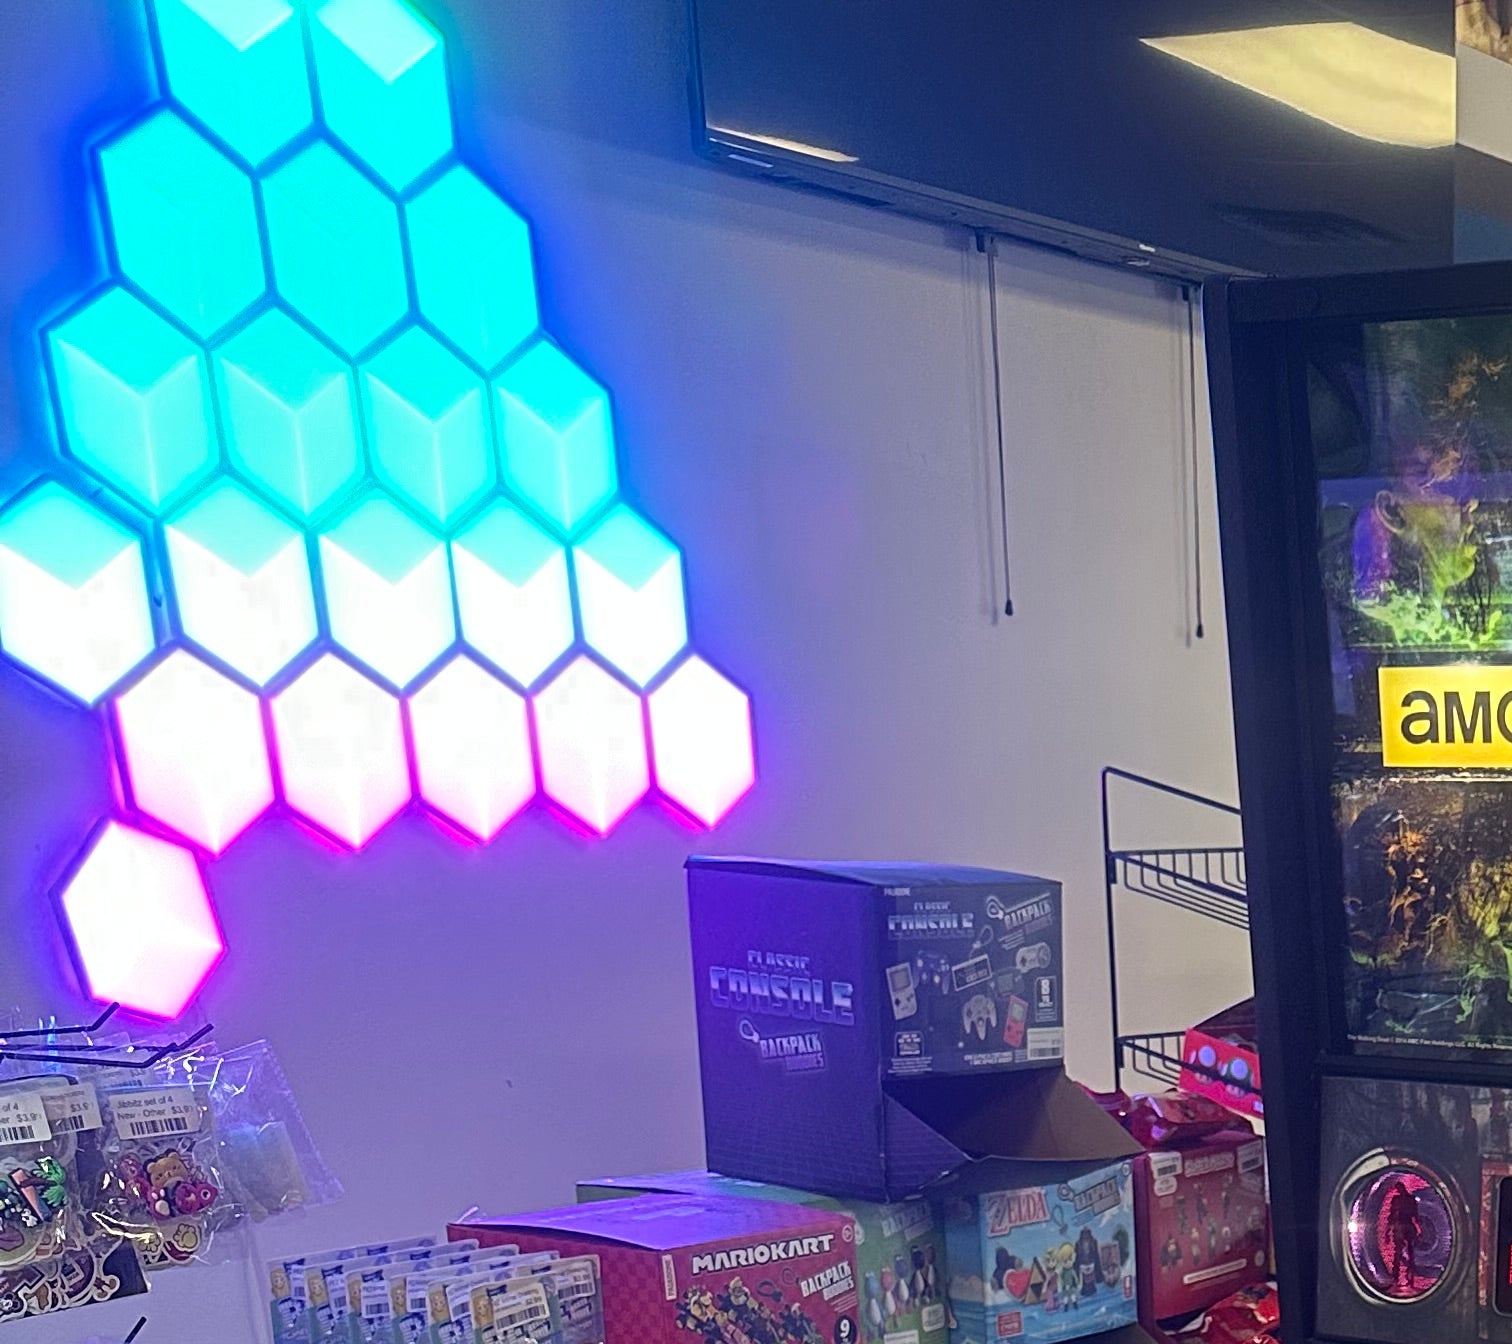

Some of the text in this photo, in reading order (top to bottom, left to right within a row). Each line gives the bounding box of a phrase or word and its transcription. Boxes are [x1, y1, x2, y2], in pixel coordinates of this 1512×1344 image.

[709, 965, 854, 1026] CONSOLE
[760, 1034, 822, 1058] BACKPACK
[17, 1112, 42, 1122] $3.9
[71, 1103, 94, 1113] $3.9
[117, 1111, 135, 1120] New
[143, 1108, 166, 1118] Other
[171, 1105, 194, 1115] $3.9
[988, 1187, 1049, 1236] ZELDA
[692, 1234, 834, 1275] MARIOKART
[800, 1261, 852, 1297] BACKPACK
[841, 1319, 850, 1338] 9
